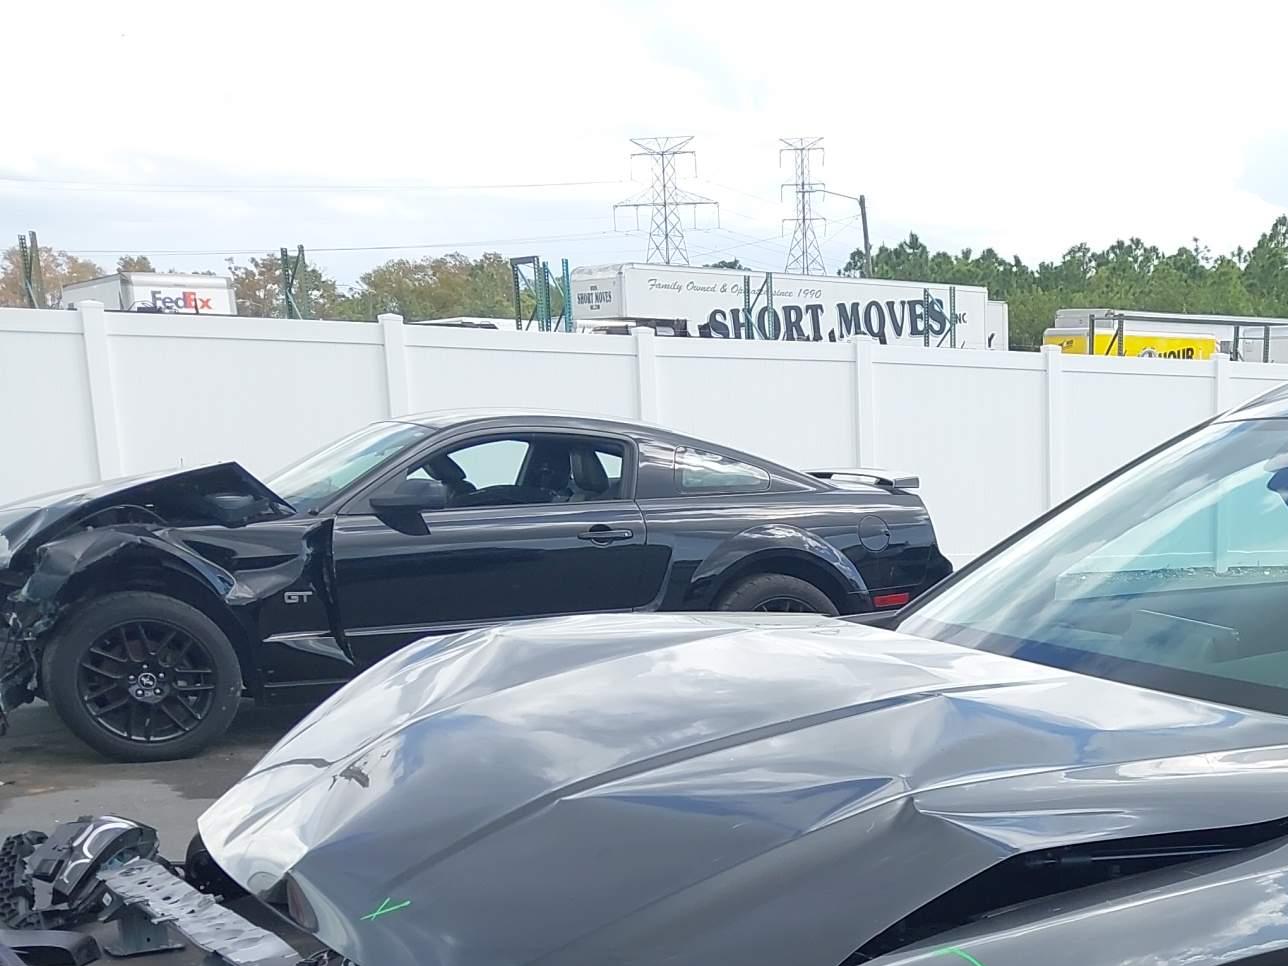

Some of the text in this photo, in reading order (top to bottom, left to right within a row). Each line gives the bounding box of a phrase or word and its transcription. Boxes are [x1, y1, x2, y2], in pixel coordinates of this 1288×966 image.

[577, 292, 594, 304] SHORT
[648, 279, 682, 292] Family
[686, 281, 717, 293] Owned
[719, 282, 728, 293] &
[797, 288, 822, 299] 1990
[151, 290, 212, 309] FedEx
[709, 299, 946, 341] SHORT MOVES
[284, 591, 313, 603] GT
